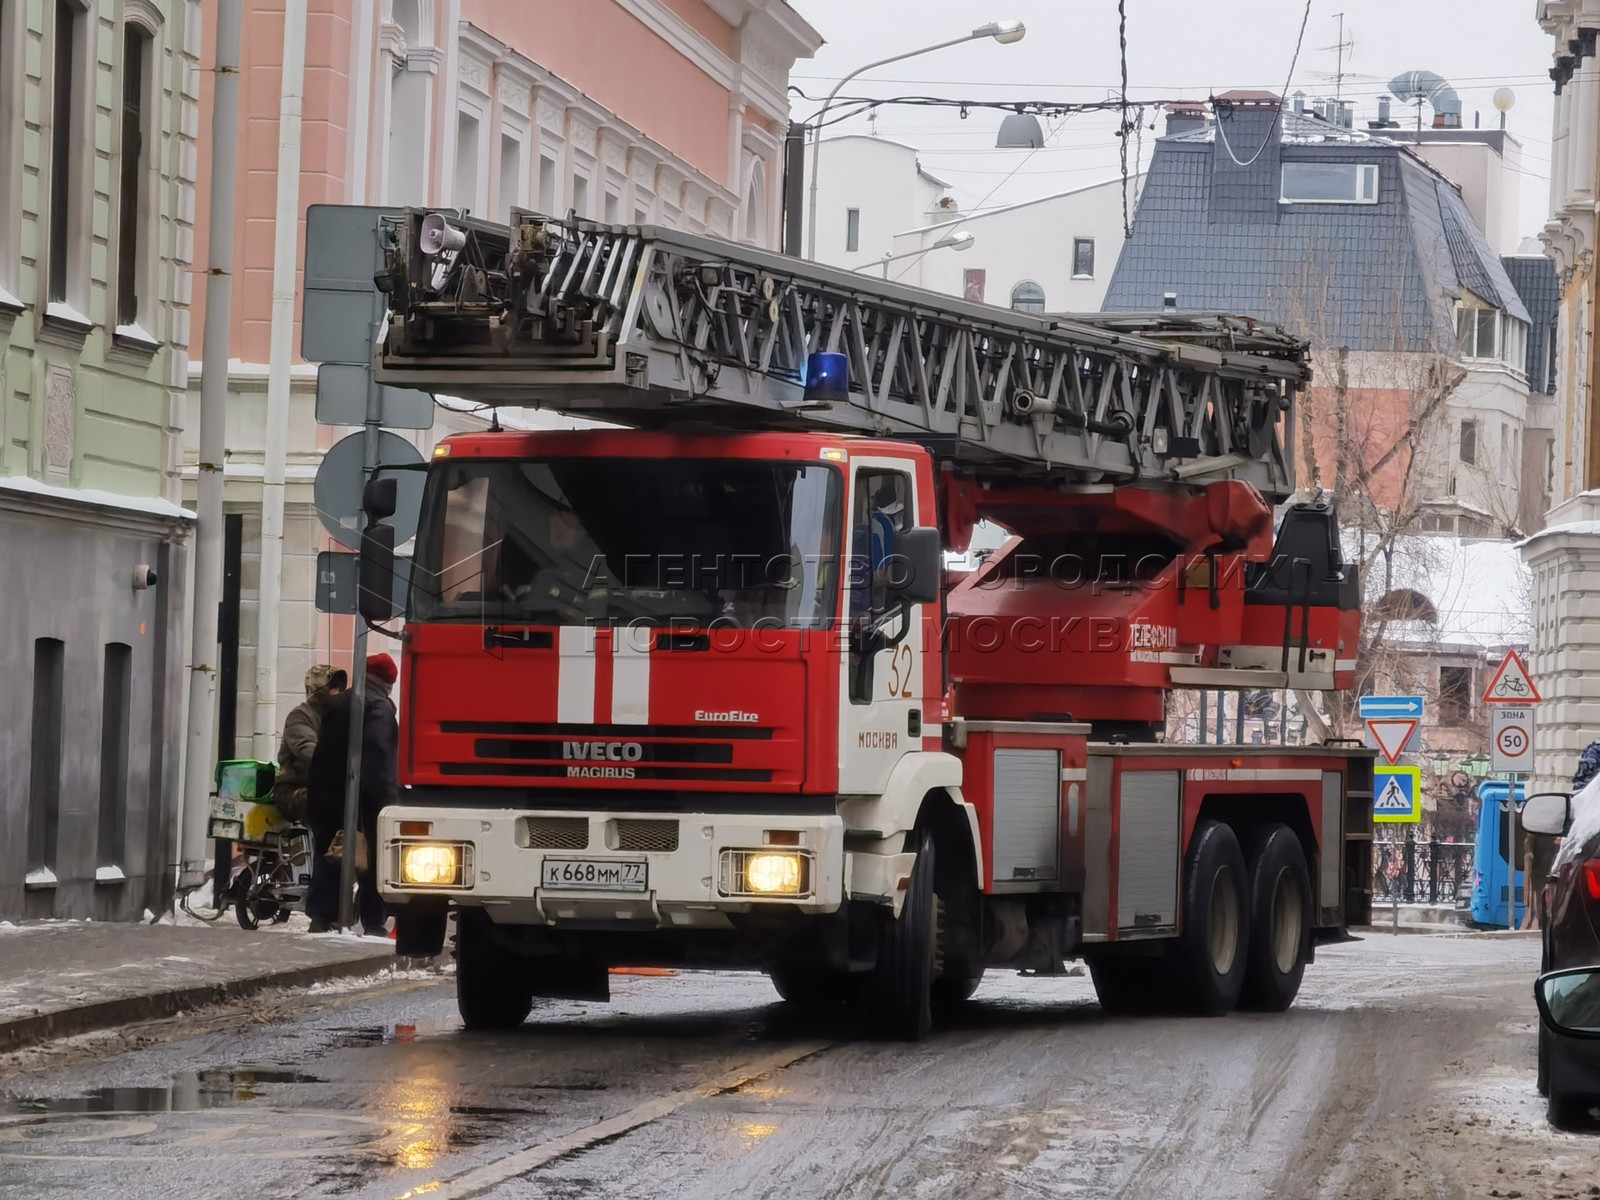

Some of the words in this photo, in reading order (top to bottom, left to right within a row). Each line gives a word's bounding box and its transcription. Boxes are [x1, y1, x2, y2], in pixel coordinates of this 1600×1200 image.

[888, 643, 913, 699] 32
[1501, 711, 1525, 719] ЗОНА
[1504, 735, 1522, 747] 50
[562, 741, 643, 762] IVECO
